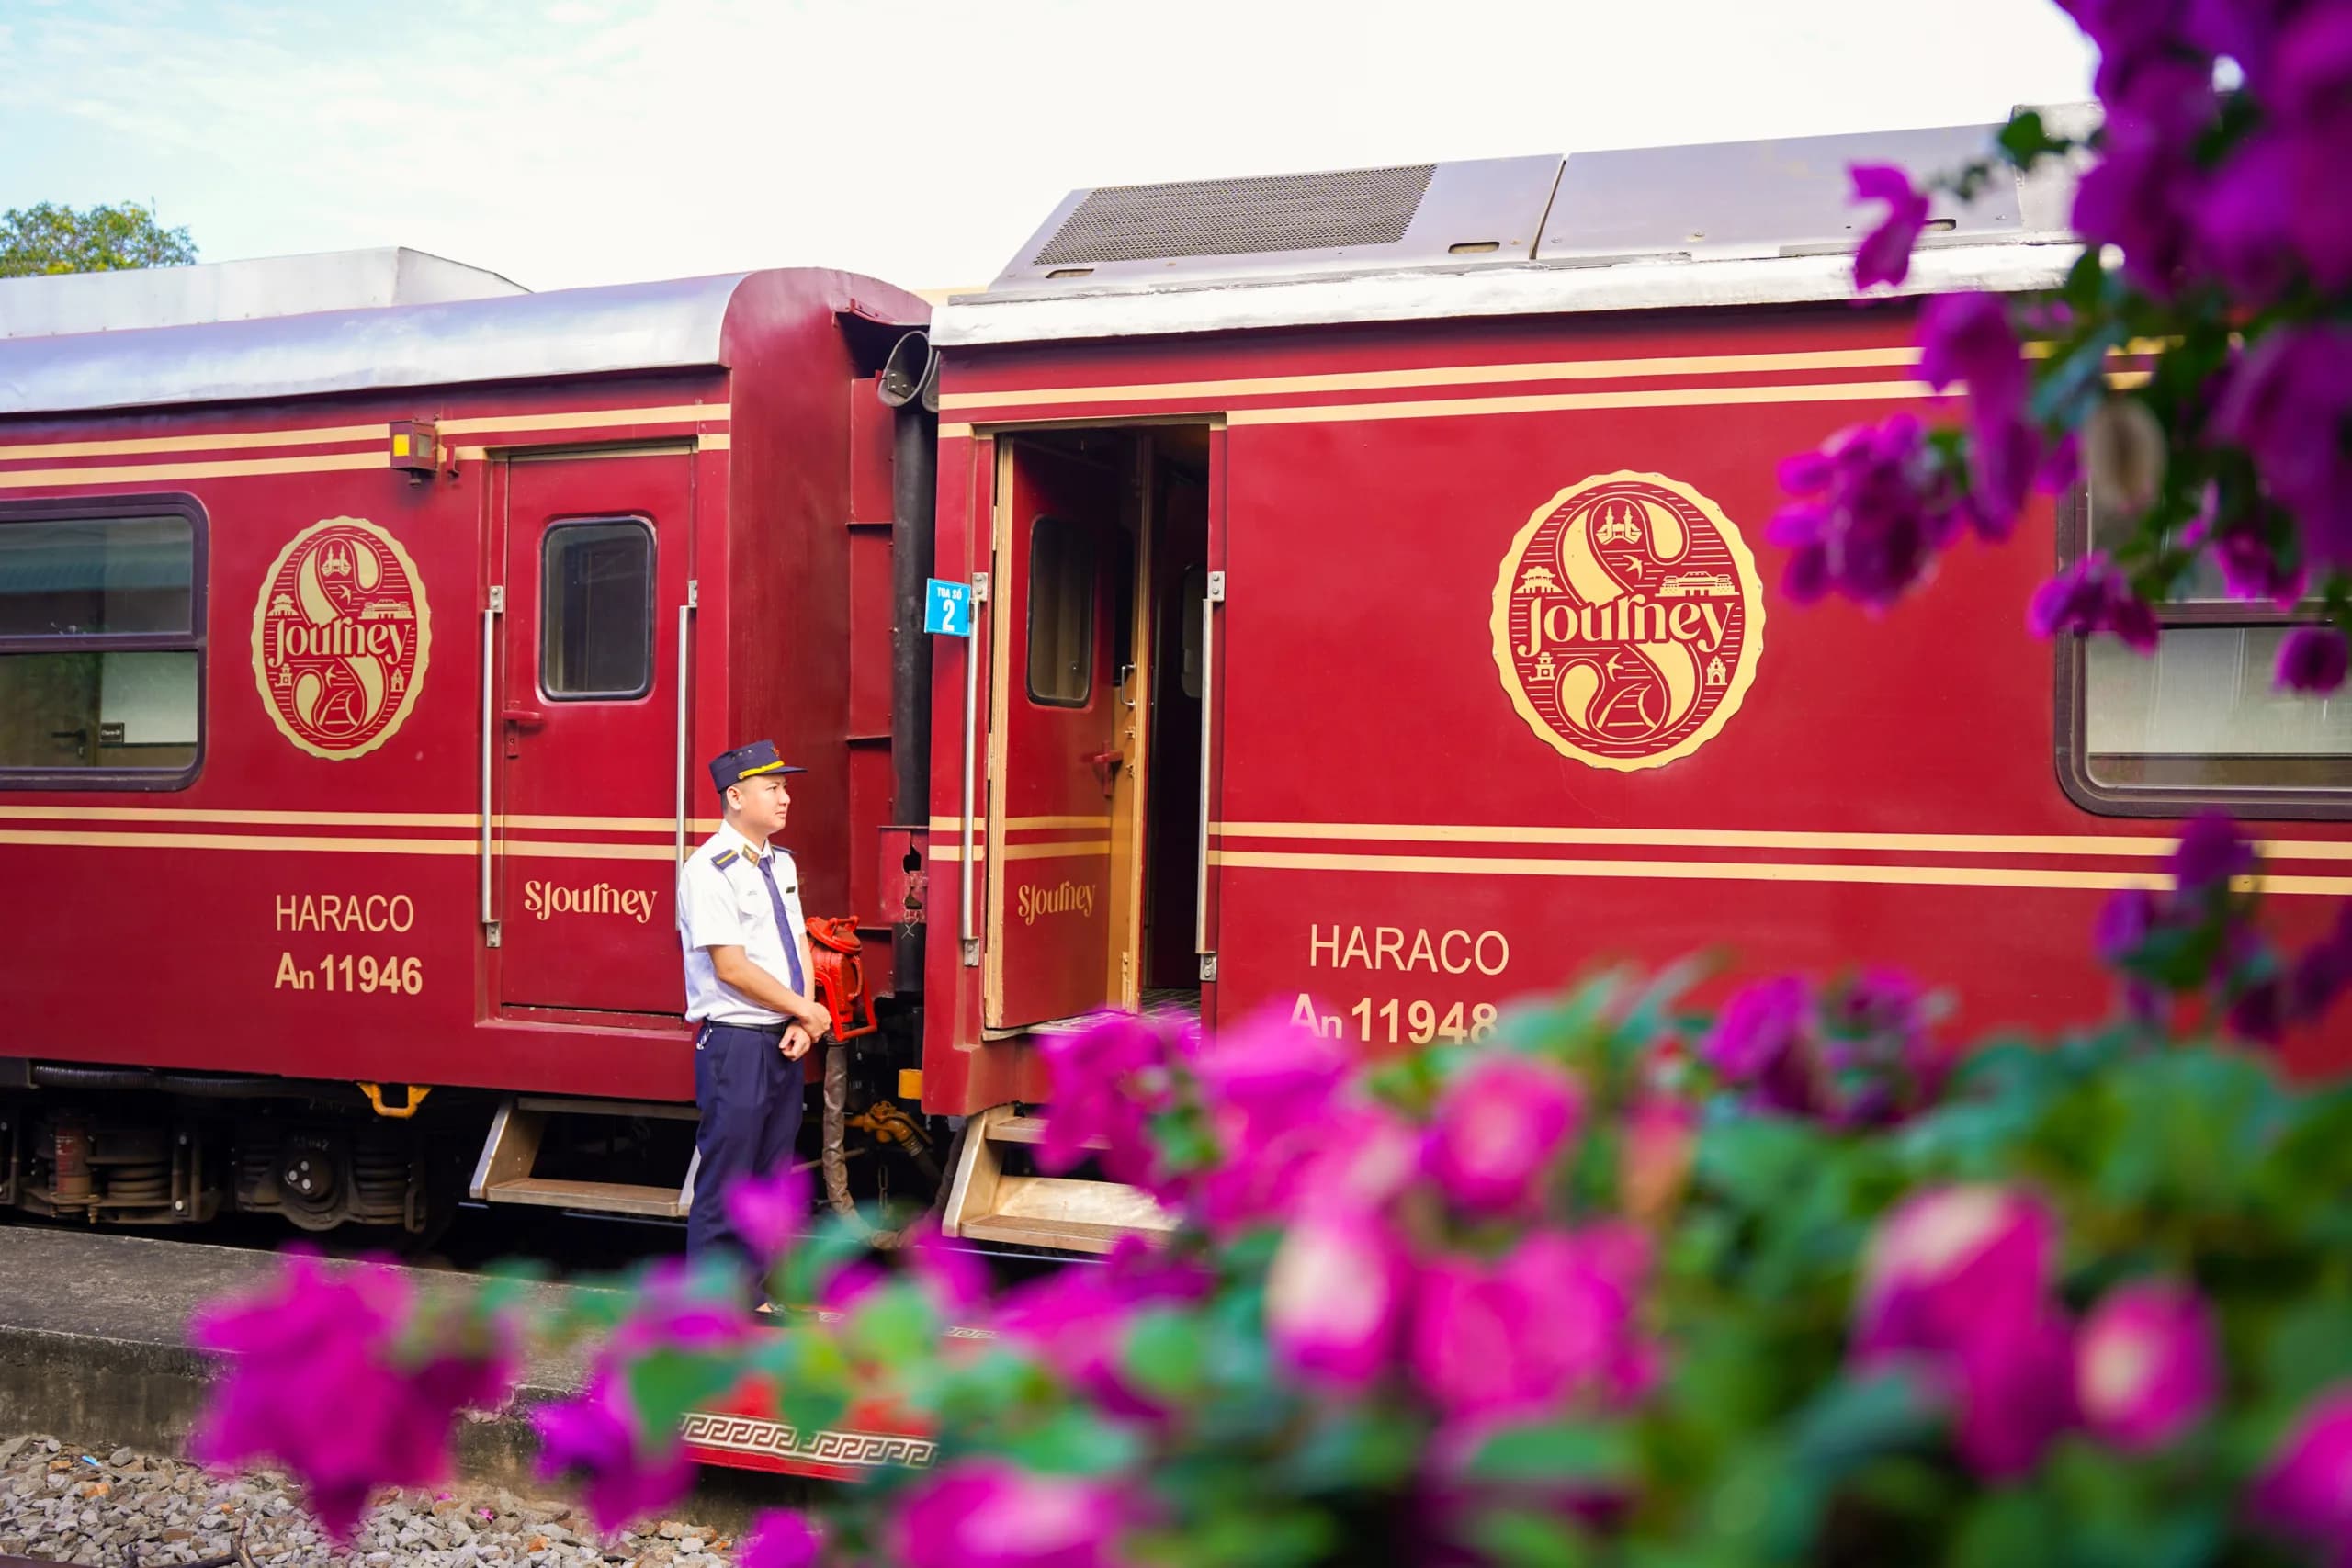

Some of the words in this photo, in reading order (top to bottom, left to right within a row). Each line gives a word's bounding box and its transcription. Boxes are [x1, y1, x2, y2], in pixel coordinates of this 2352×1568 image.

[942, 599, 956, 632] 2
[1517, 593, 1736, 658] Journey
[267, 616, 413, 668] Journey
[276, 894, 414, 932] HARACO
[274, 952, 315, 990] An
[320, 954, 423, 995] 11946
[1309, 923, 1510, 976] HARACO
[1290, 993, 1343, 1040] An
[1351, 998, 1498, 1045] 11948
